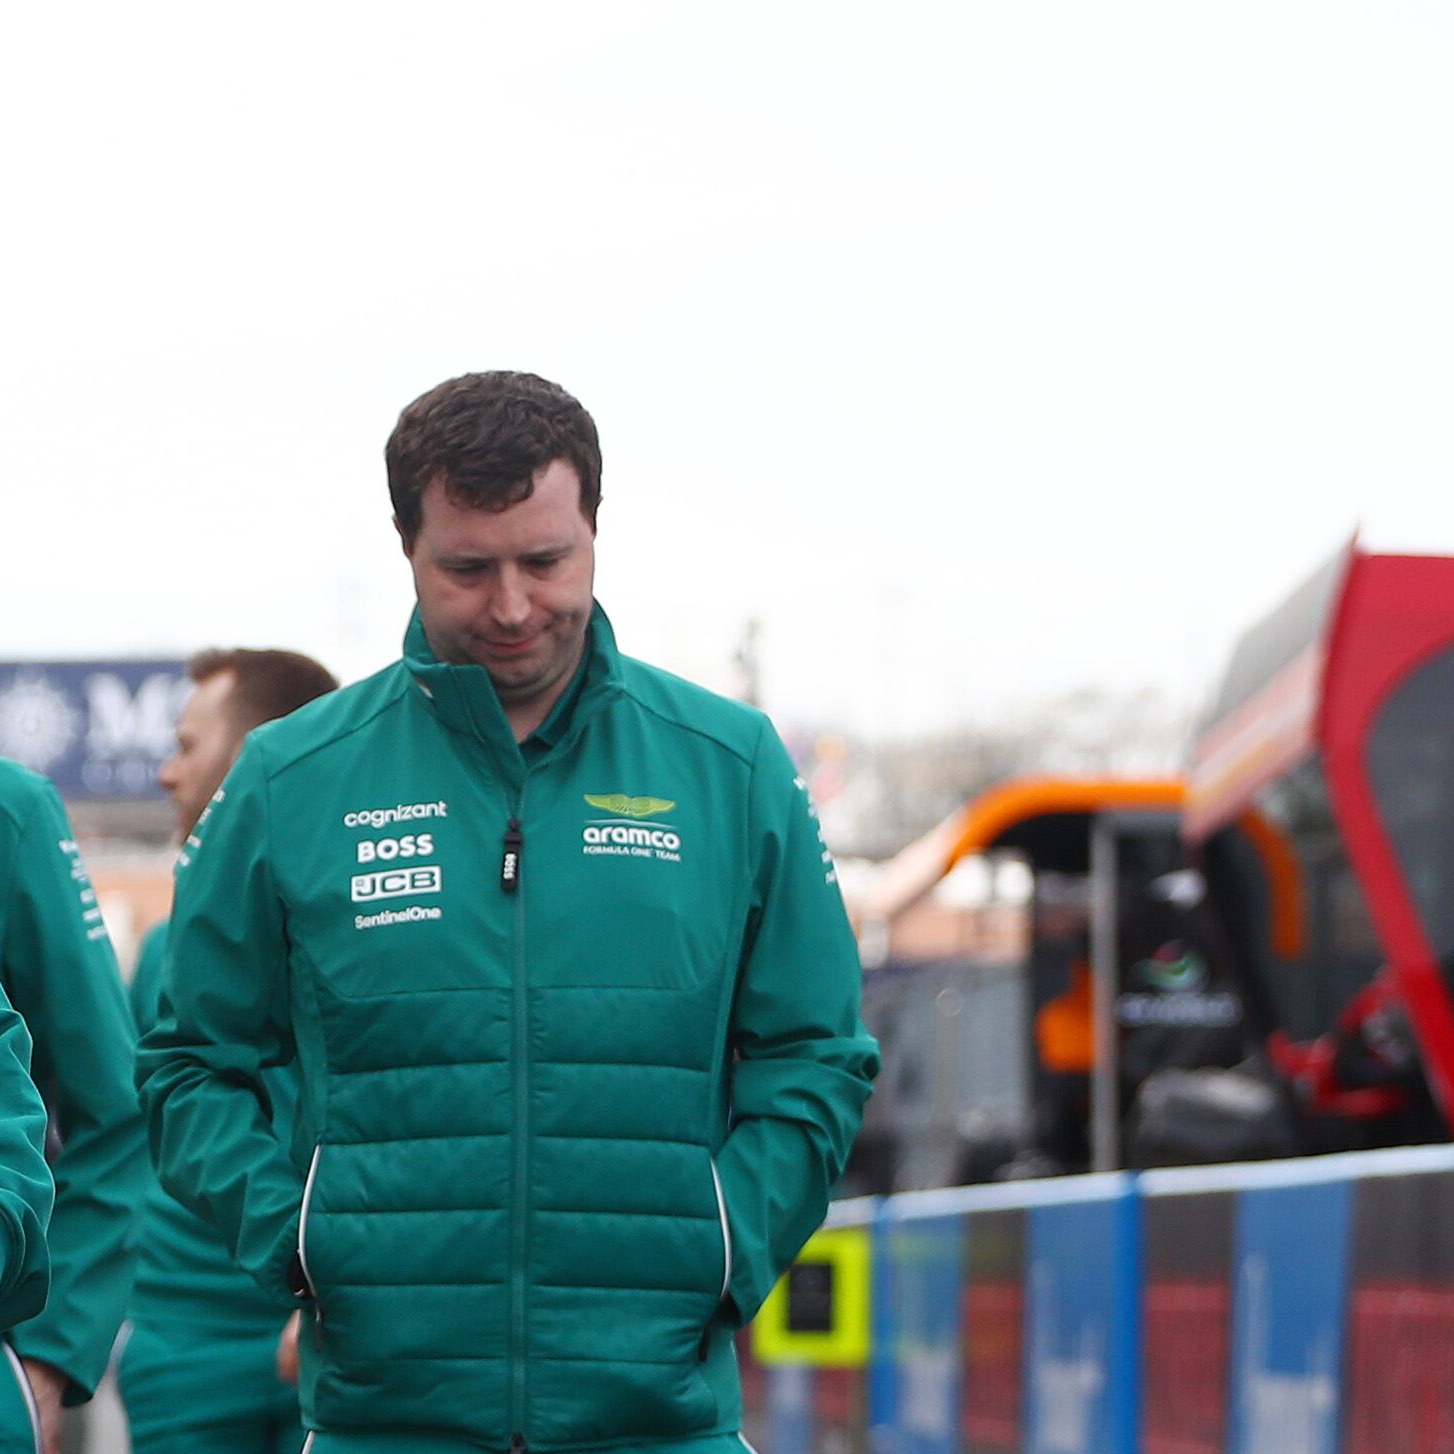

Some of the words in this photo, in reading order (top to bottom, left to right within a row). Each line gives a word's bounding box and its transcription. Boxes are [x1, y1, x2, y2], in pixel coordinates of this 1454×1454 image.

[344, 800, 448, 828] cognizant
[357, 834, 434, 863] BOSS
[583, 826, 681, 850] aramco
[503, 853, 517, 880] BOSS
[354, 869, 437, 898] JCB
[354, 906, 441, 929] SentinelOne
